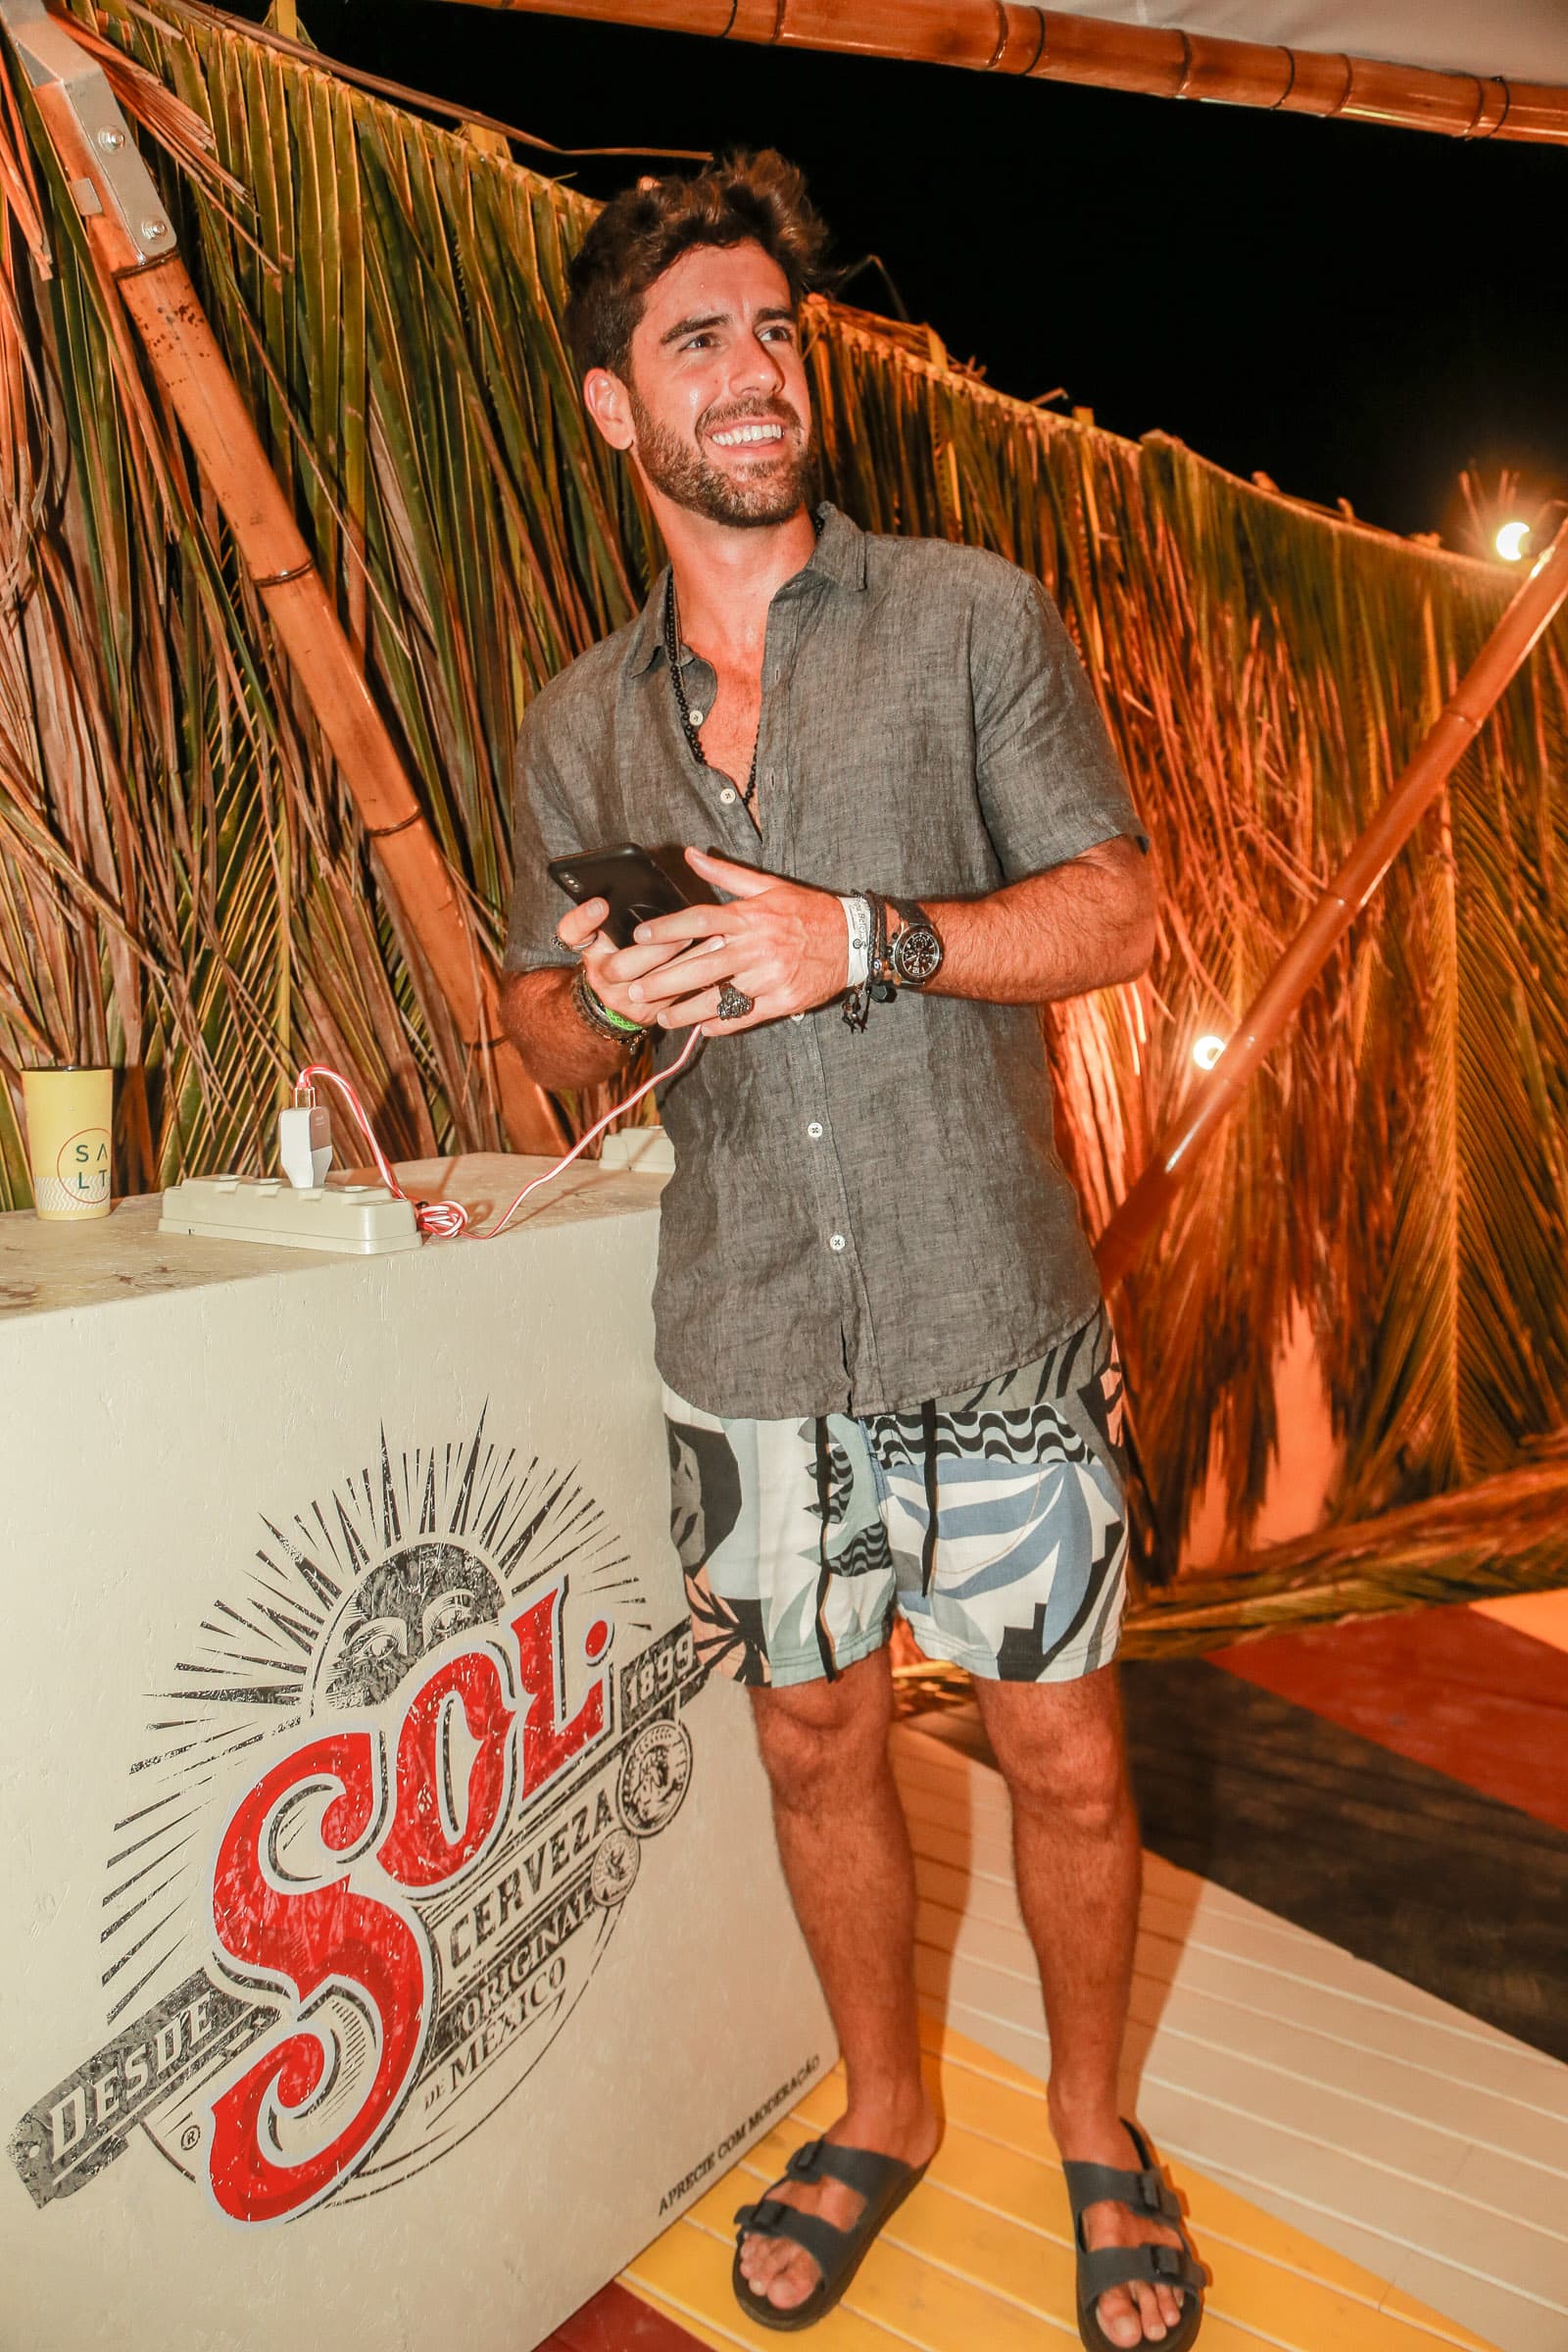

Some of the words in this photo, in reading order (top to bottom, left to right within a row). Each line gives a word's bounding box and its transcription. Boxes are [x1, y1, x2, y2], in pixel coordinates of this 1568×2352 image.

[626, 1630, 694, 1711] 1899
[450, 1788, 612, 1969] CERVEZA
[462, 1886, 596, 2033] ORIGINAL
[48, 1990, 213, 2165] DESDE
[659, 2151, 715, 2218] APRECIE
[717, 2123, 747, 2160] COM
